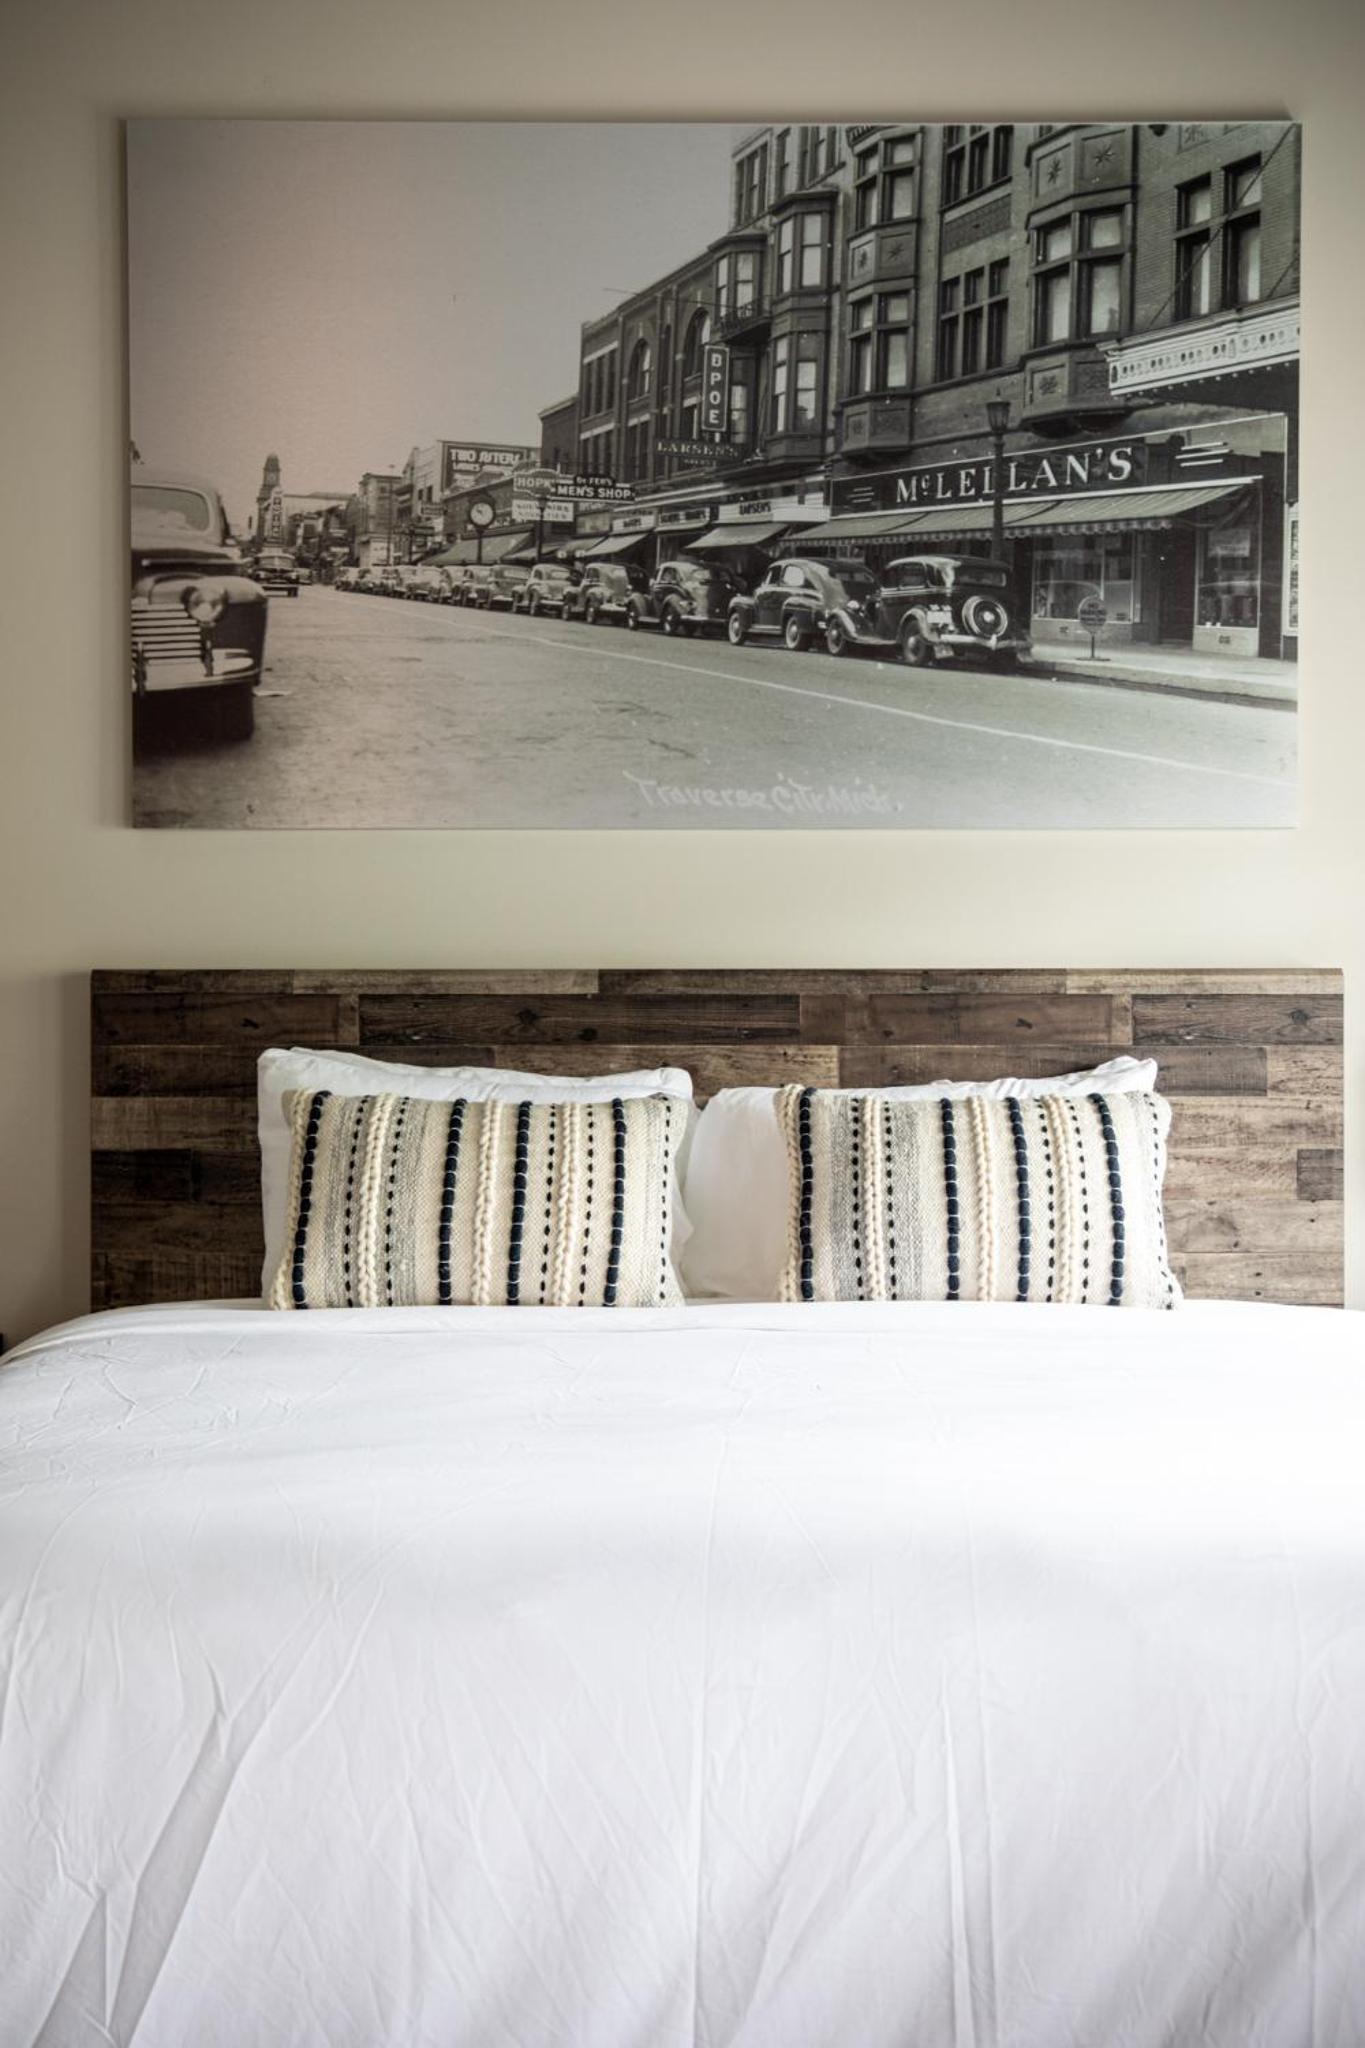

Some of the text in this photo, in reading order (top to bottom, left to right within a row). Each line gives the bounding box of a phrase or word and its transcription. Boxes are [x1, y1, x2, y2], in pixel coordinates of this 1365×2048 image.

[709, 353, 722, 424] BPOE
[557, 485, 632, 499] MEN'S SHOP
